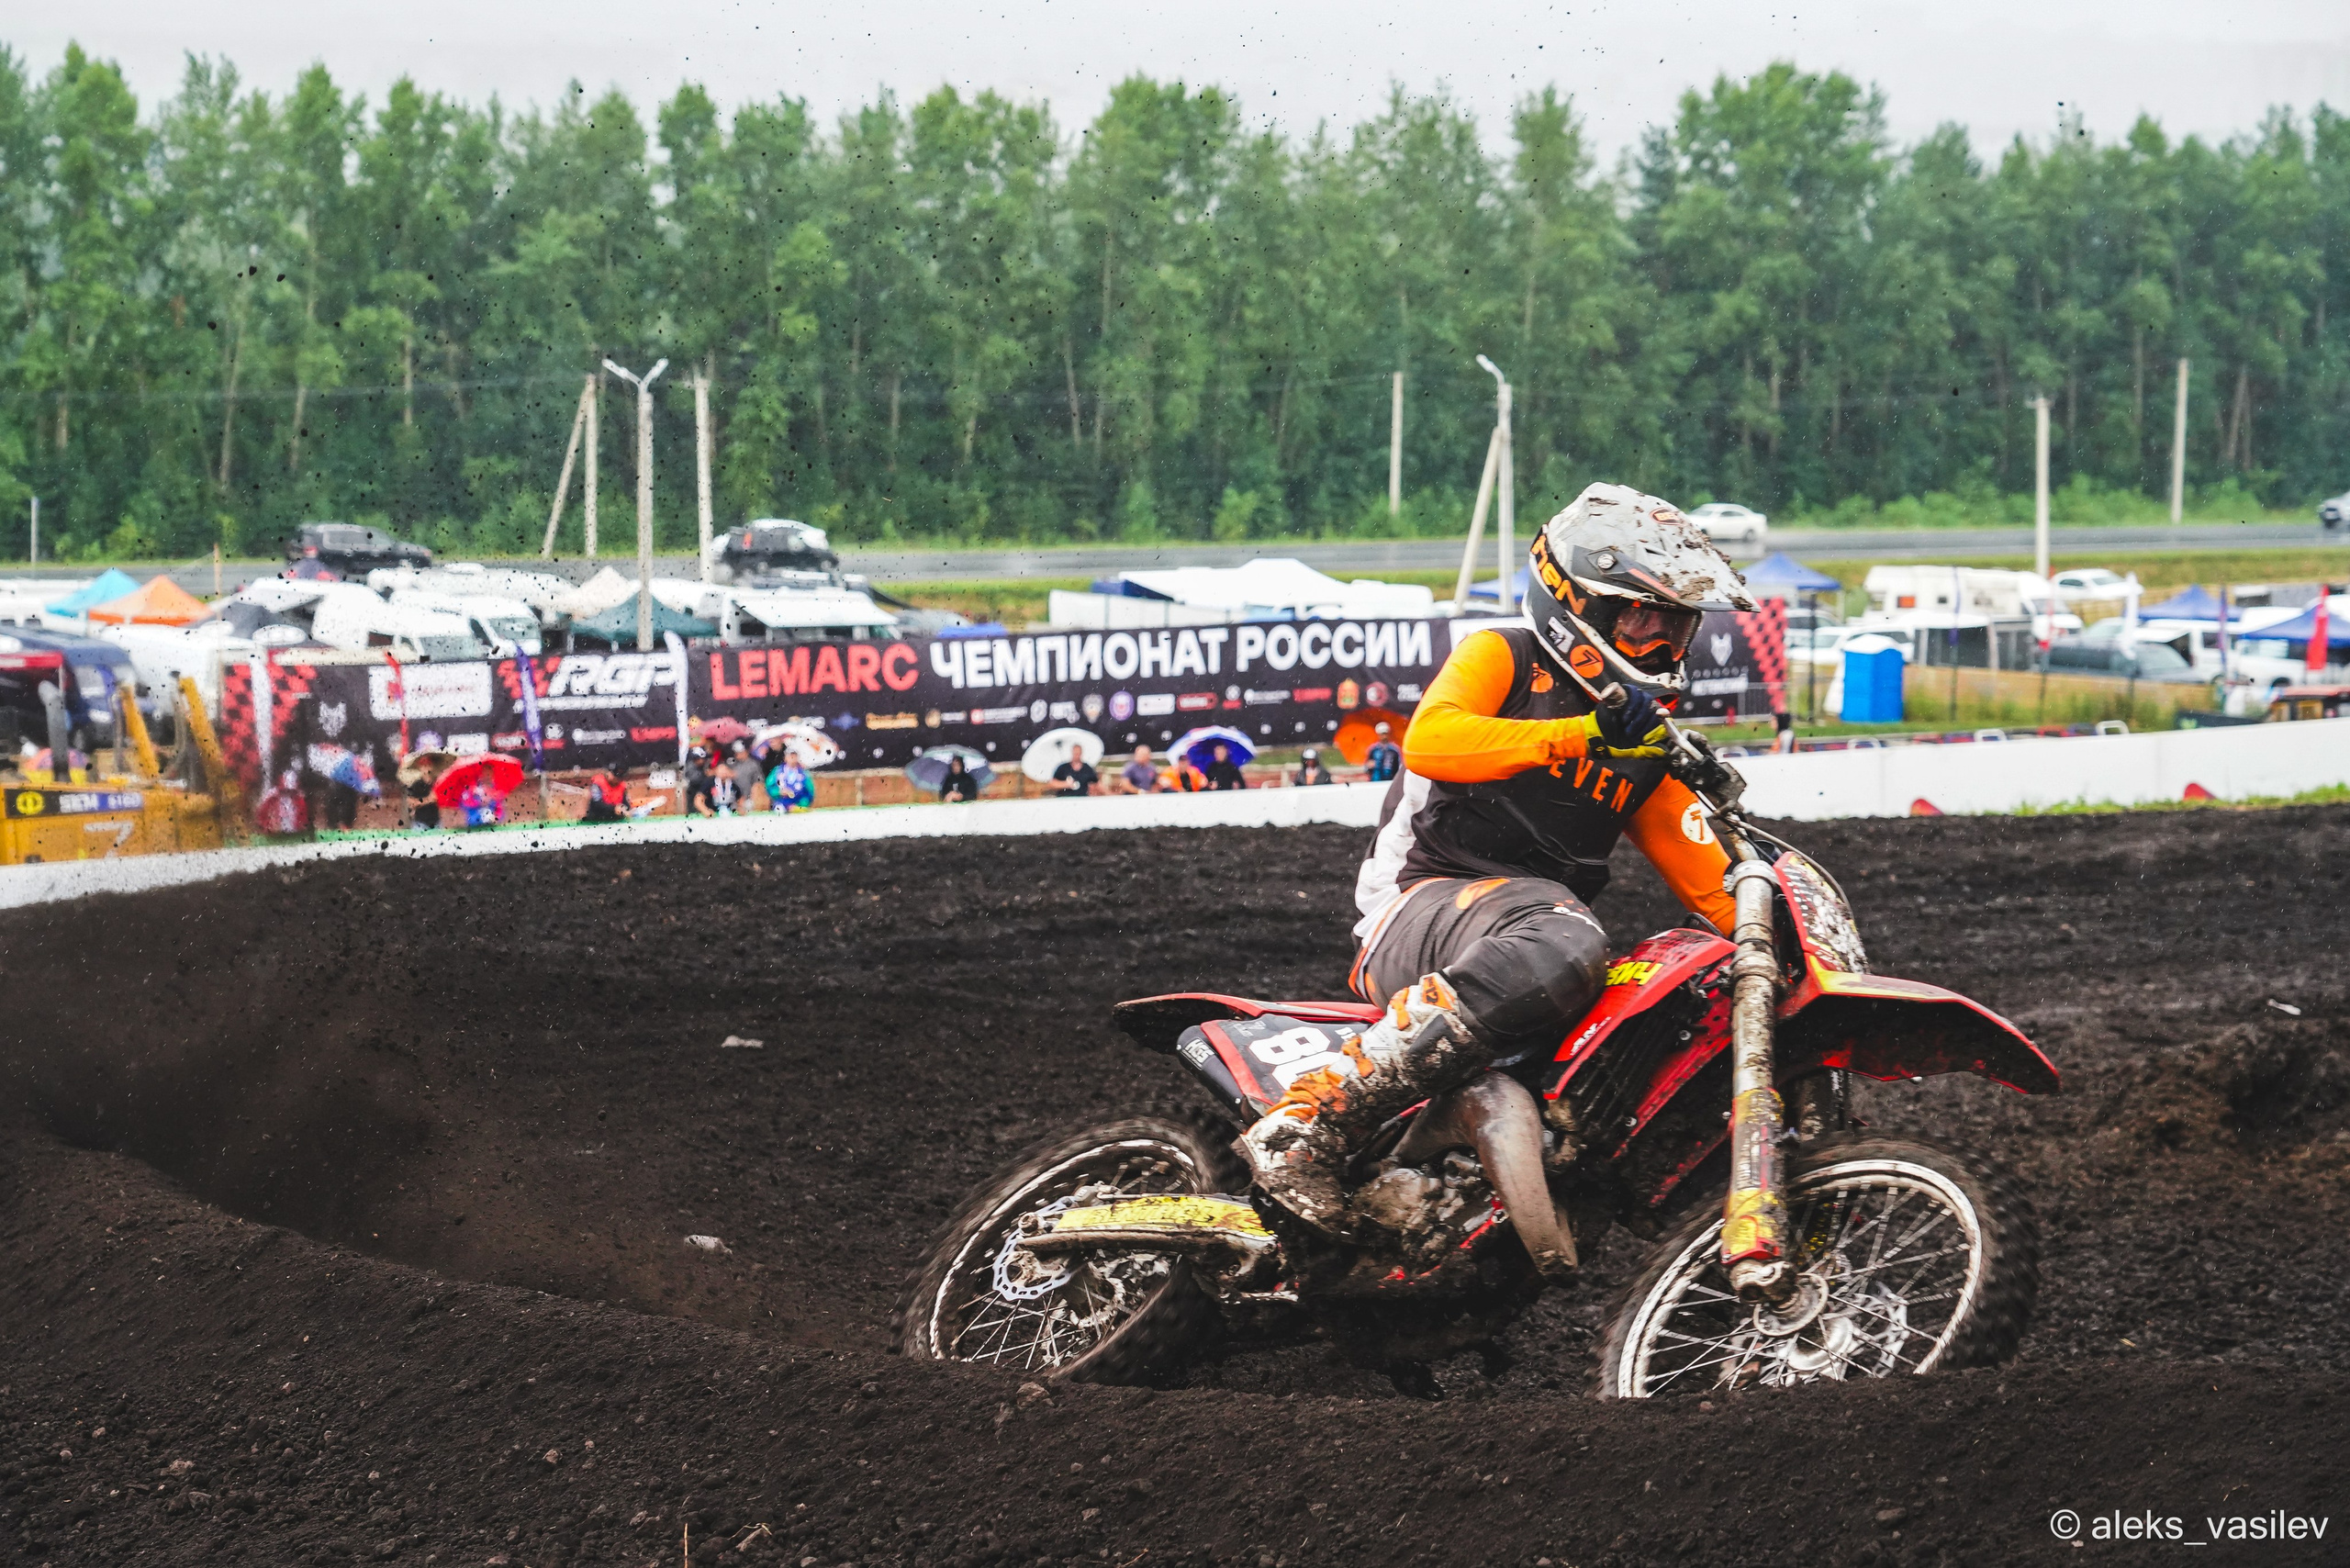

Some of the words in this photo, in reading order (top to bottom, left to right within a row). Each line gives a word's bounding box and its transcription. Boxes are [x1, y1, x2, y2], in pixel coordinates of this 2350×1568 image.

[710, 643, 919, 700] LEMARC
[930, 627, 1229, 689] ЧЕМПИОНАТ
[1236, 621, 1433, 673] РОССИИ
[1549, 756, 1634, 813] EVEN
